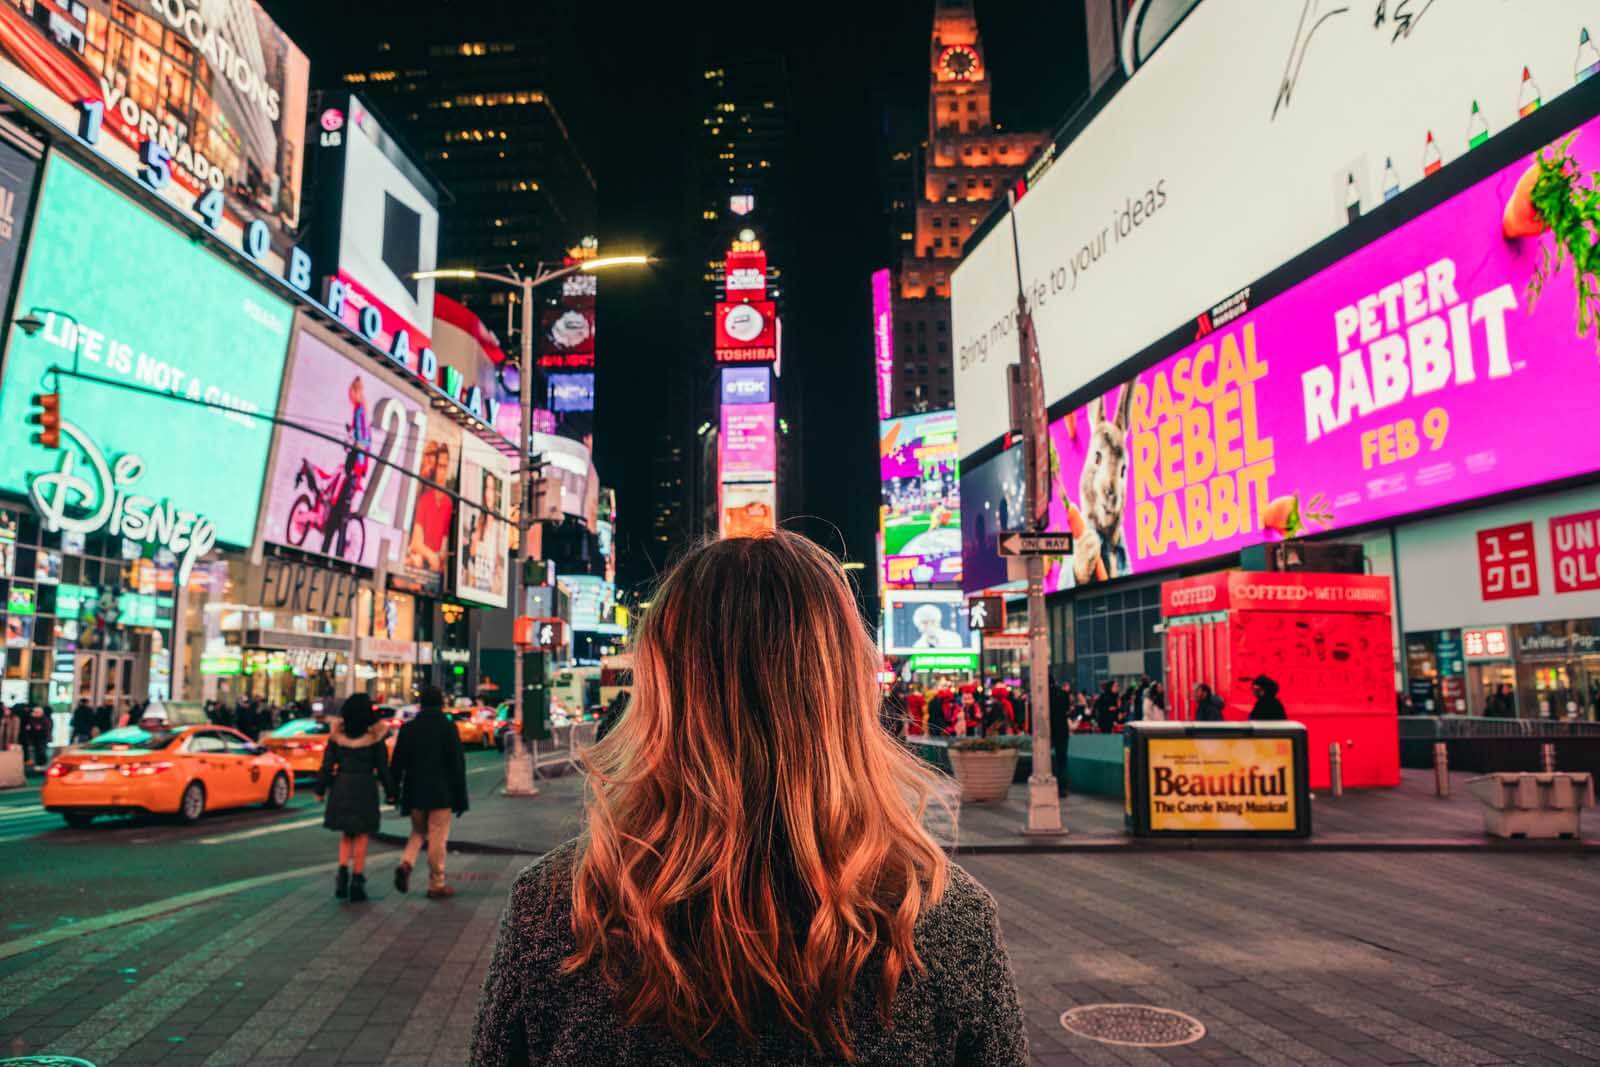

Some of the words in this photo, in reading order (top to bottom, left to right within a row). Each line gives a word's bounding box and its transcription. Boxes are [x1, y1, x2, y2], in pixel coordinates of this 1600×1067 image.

[100, 76, 224, 190] VORNADO
[320, 131, 341, 147] LG
[82, 100, 271, 259] 1540
[290, 246, 500, 426] BROADWAY
[960, 334, 987, 371] Bring
[990, 307, 1019, 347] mor
[1050, 266, 1066, 295] to
[1070, 226, 1109, 290] your
[1114, 178, 1167, 243] ideas
[1334, 257, 1460, 354] PETER
[42, 311, 105, 363] LIFE
[106, 339, 134, 374] IS
[136, 352, 186, 394] NOT
[185, 378, 201, 401] A
[715, 348, 776, 362] TOSHIBA
[1131, 321, 1268, 433] RASCAL
[1301, 283, 1518, 444] RABBIT
[367, 398, 428, 532] 21
[1133, 381, 1274, 501] REBEL
[1360, 417, 1419, 470] FEB
[1423, 407, 1449, 451] 9
[1045, 537, 1067, 550] WAY
[1136, 457, 1275, 560] RABBIT
[1234, 584, 1307, 600] COFFEED
[1153, 766, 1288, 797] Beautiful
[1154, 801, 1175, 813] The
[1177, 801, 1214, 813] Carole
[1216, 801, 1242, 815] King
[1246, 801, 1288, 813] Musical
